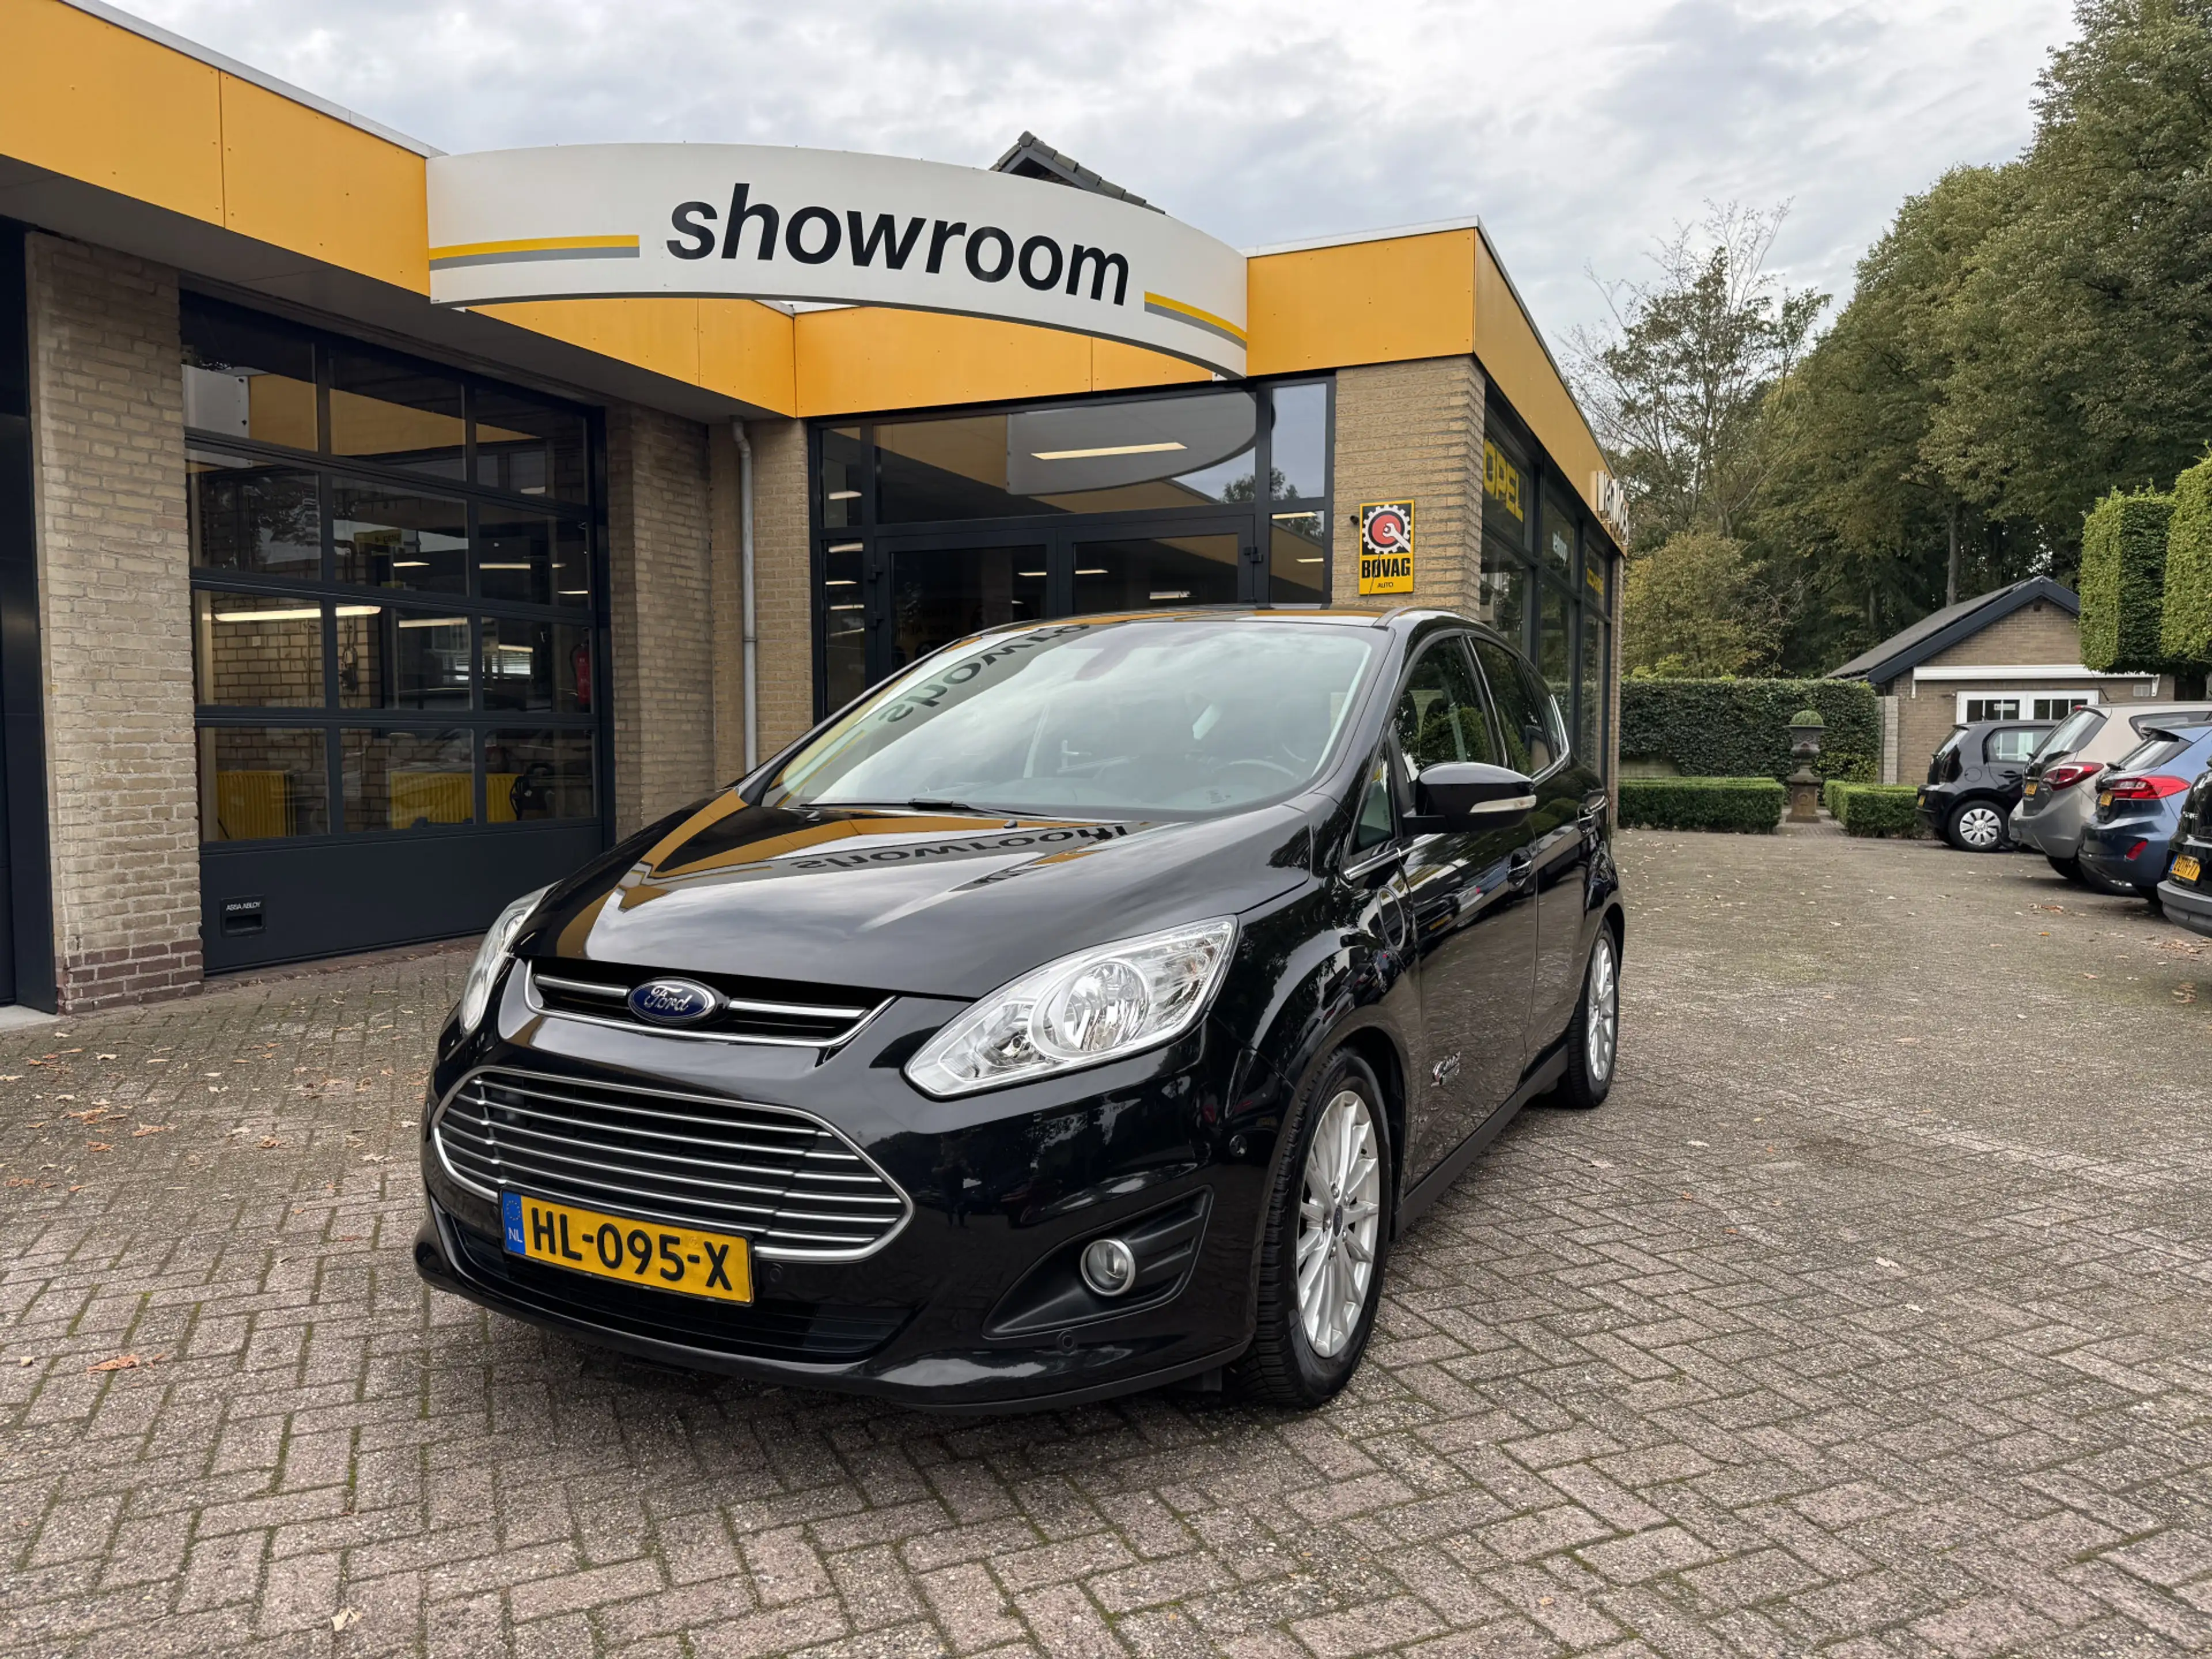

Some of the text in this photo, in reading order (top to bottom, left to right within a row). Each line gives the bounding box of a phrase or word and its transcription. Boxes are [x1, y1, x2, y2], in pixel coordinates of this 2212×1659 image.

[666, 182, 1130, 307] showroom
[1483, 438, 1524, 522] OPEL
[1361, 557, 1411, 578] BOVAG
[643, 984, 694, 1012] Ford
[508, 1207, 733, 1291] NL HL-095-X
